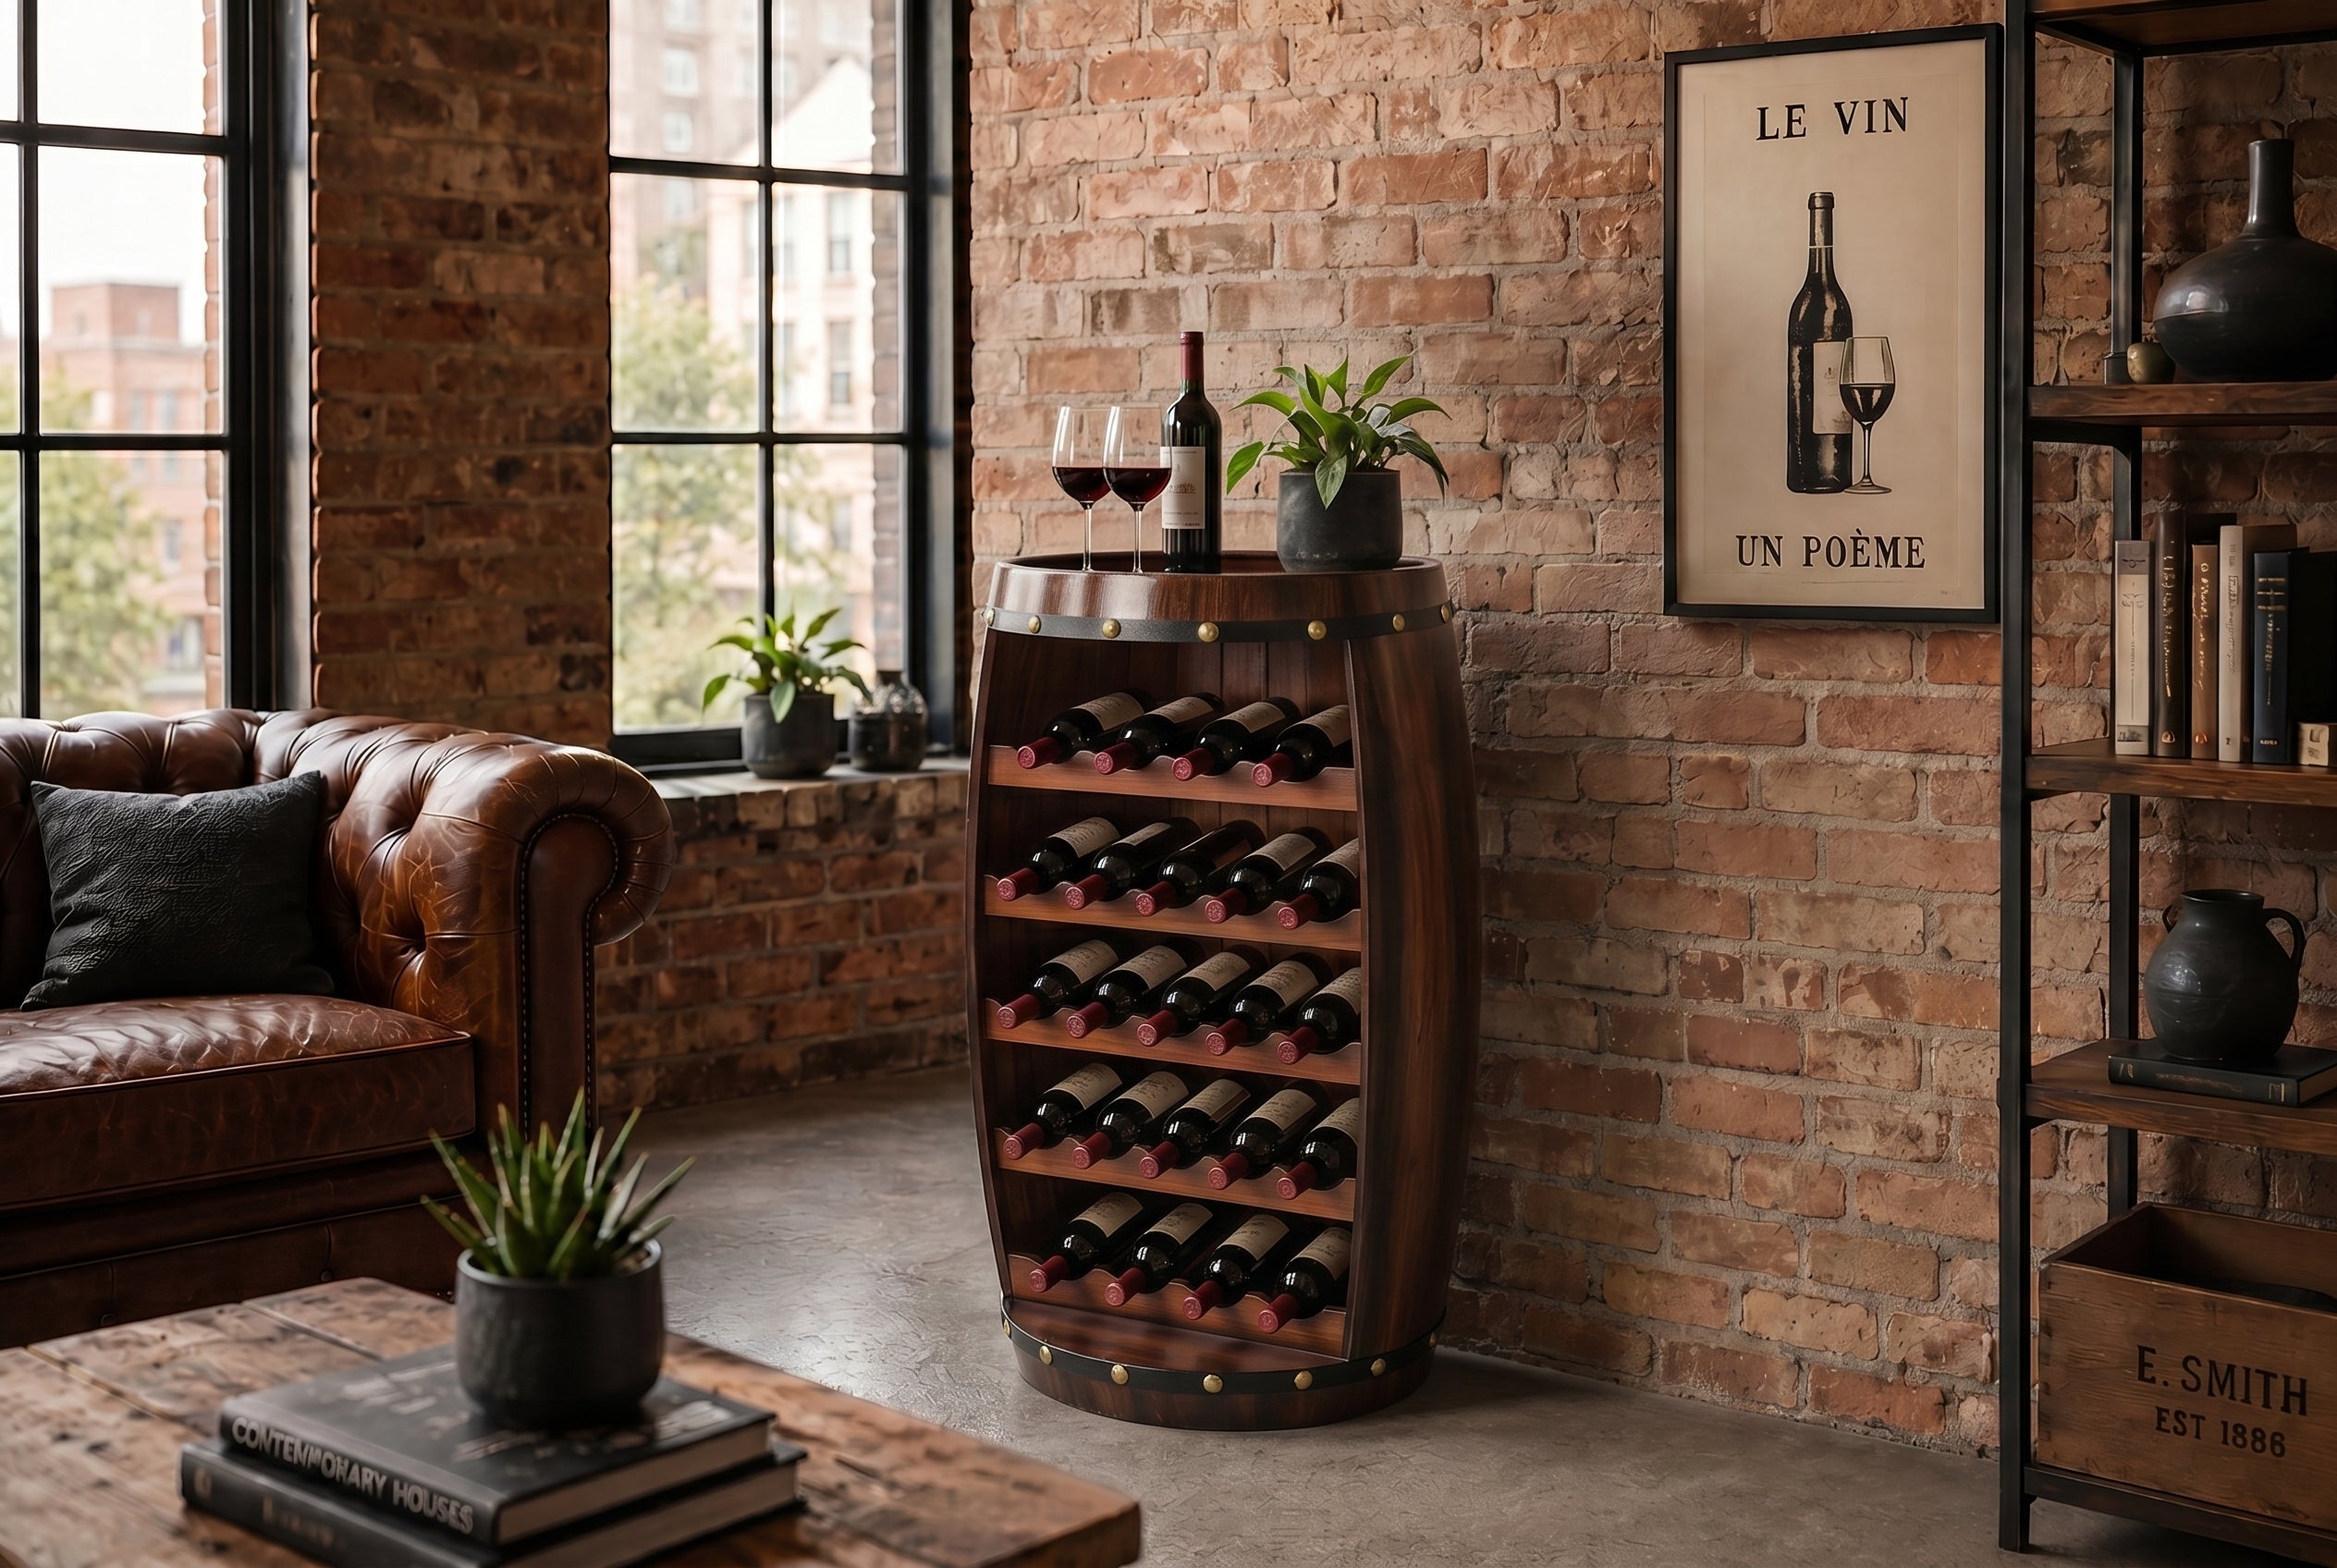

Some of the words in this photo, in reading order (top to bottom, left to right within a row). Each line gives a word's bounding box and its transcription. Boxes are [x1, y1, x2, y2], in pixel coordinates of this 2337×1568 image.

[1756, 104, 1808, 141] LE
[1833, 96, 1909, 135] VIN
[1735, 534, 1784, 568] UN
[1802, 527, 1927, 570] POÈME
[2136, 1345, 2170, 1387] E.
[2180, 1354, 2308, 1416] SMITH
[2154, 1405, 2207, 1440] EST
[2220, 1420, 2287, 1459] 1886
[392, 1478, 474, 1535] HOUSES
